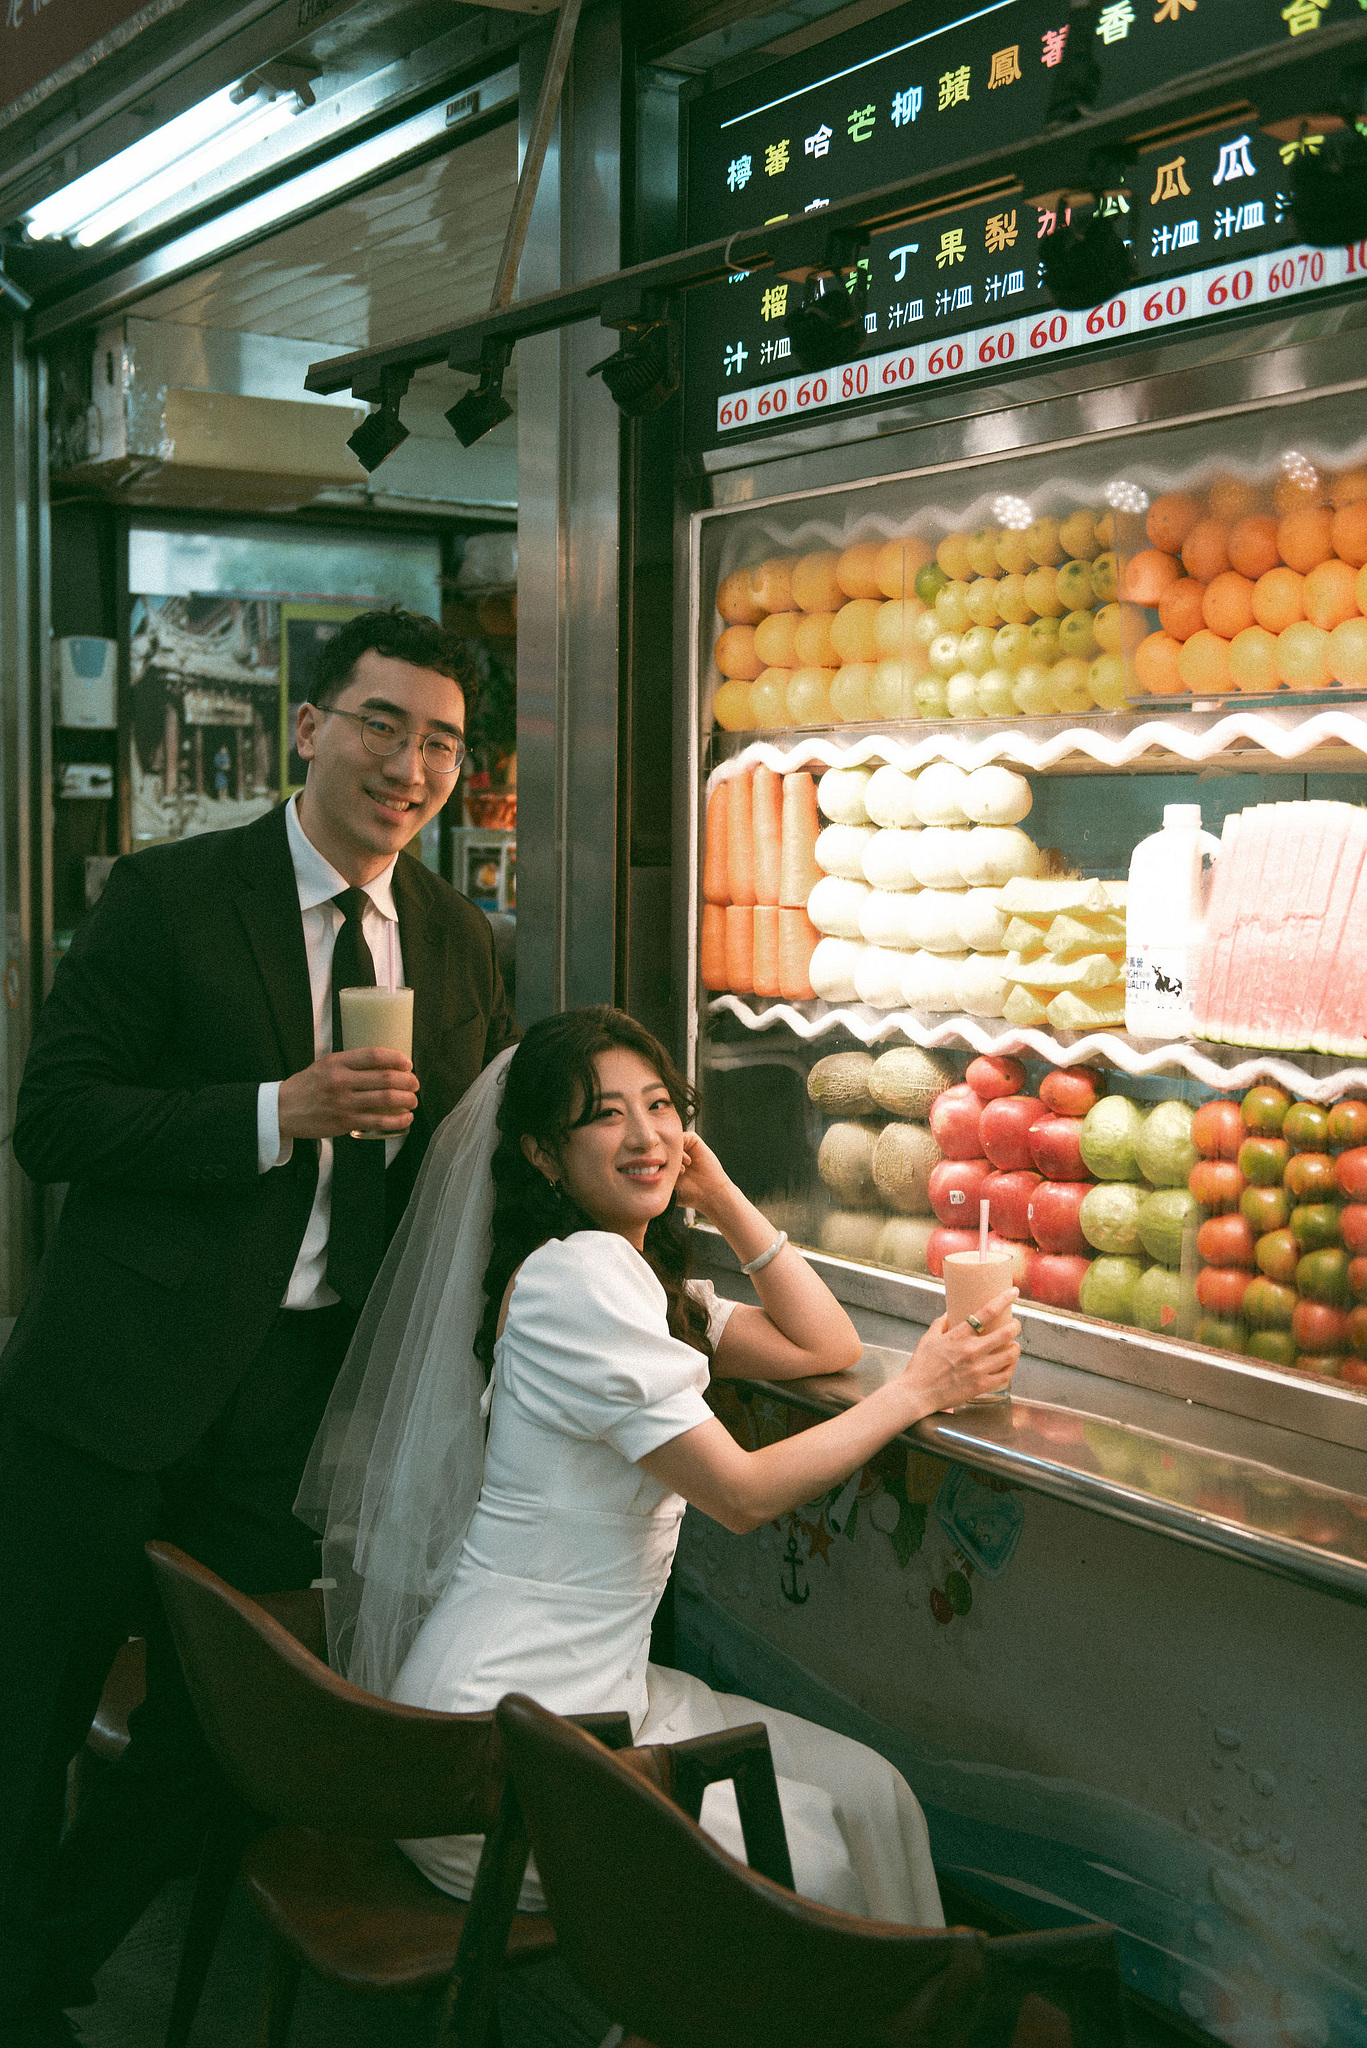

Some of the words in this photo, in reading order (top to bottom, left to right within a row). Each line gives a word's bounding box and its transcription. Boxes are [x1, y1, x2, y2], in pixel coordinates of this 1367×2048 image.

[721, 399, 747, 424] 60
[758, 389, 786, 415] 60
[797, 379, 827, 406] 60
[842, 365, 867, 397] 80
[883, 358, 914, 384] 60
[929, 344, 963, 374] 60
[979, 333, 1014, 362] 60
[1030, 316, 1067, 348] 60
[1087, 301, 1125, 334] 60
[1144, 287, 1185, 321] 60
[1208, 271, 1252, 305] 60
[1126, 980, 1150, 990] UALITY
